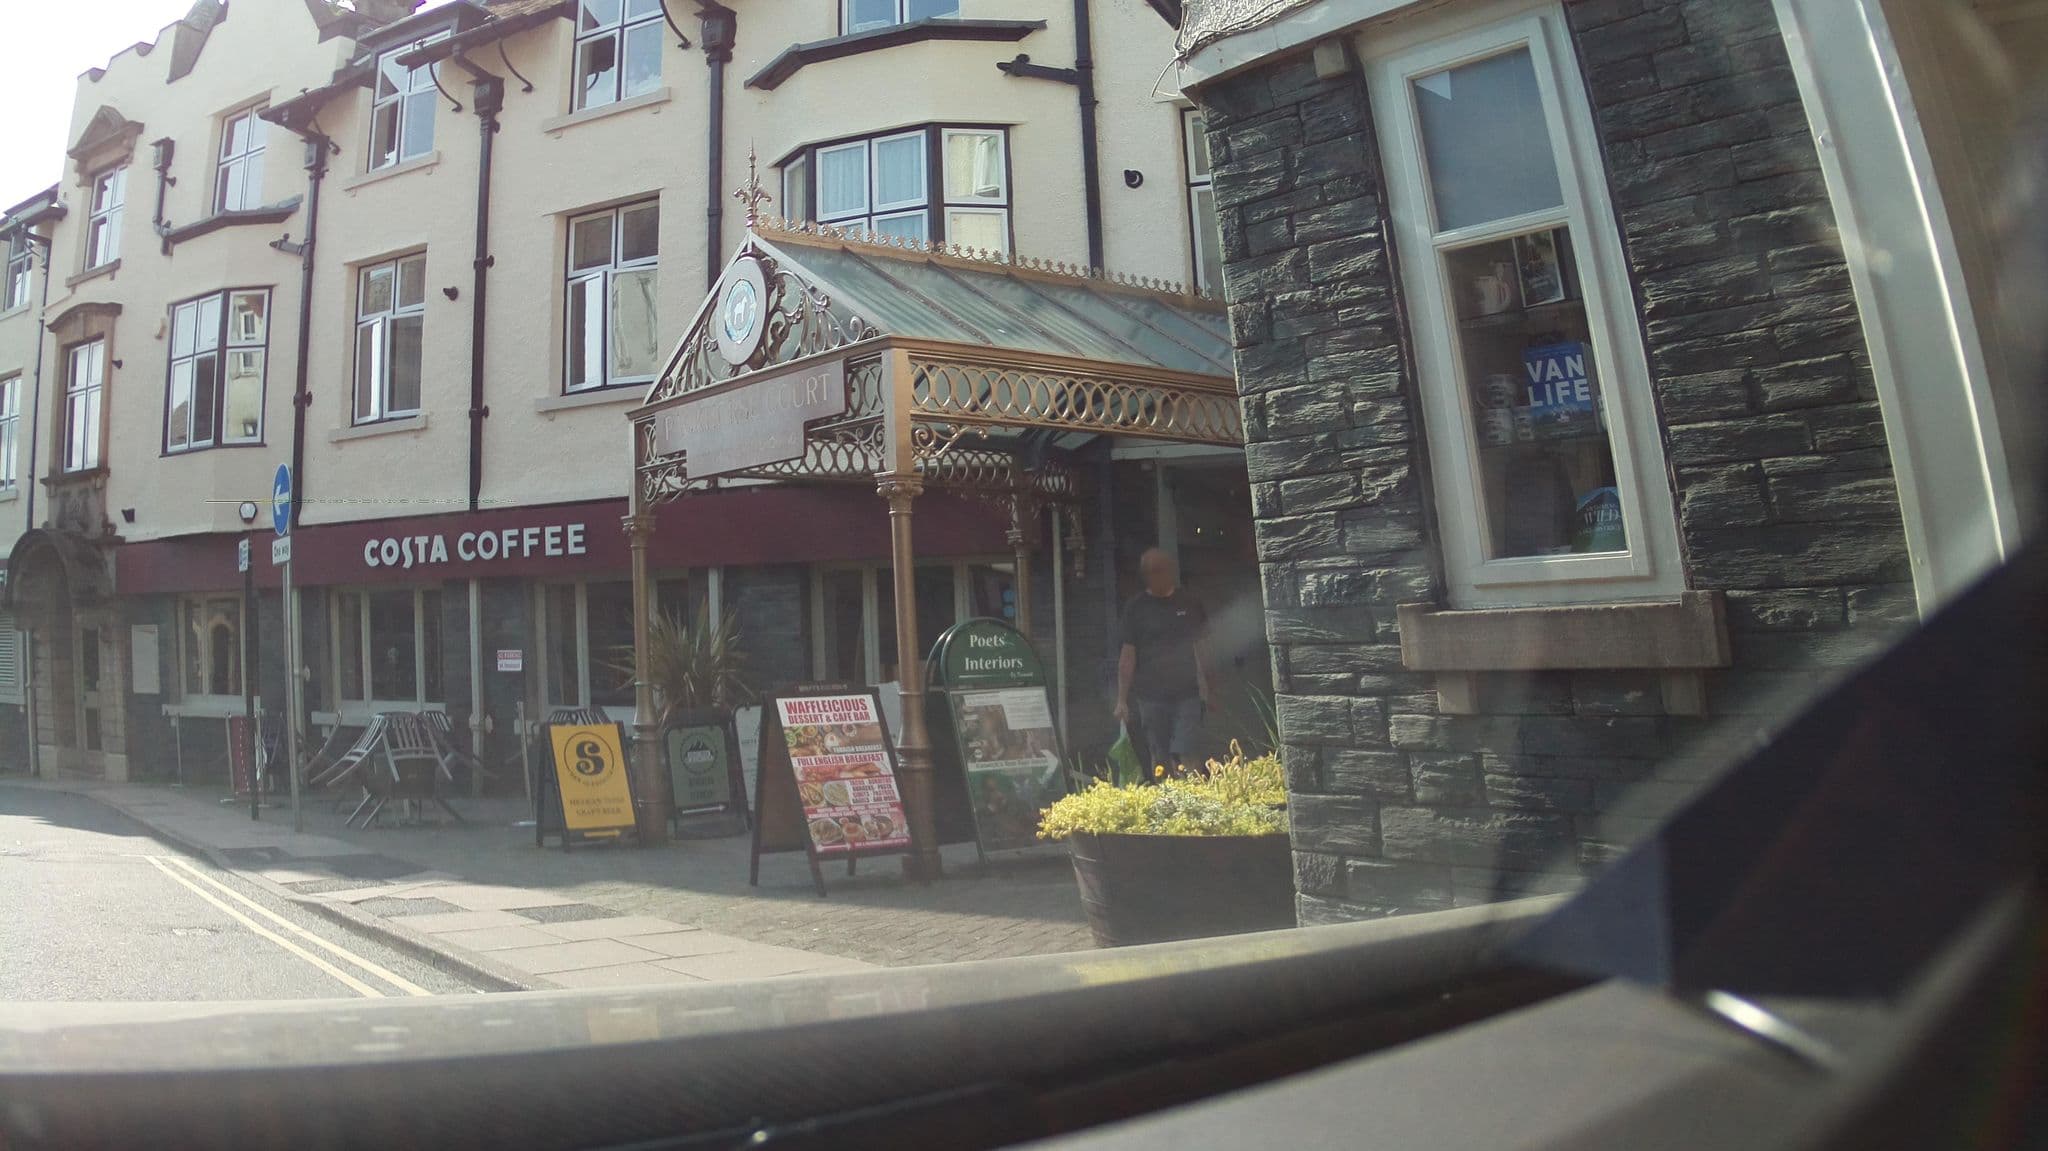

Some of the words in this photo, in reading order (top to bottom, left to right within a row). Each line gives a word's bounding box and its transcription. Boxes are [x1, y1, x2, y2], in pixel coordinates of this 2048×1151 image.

[1526, 354, 1585, 383] VAN
[766, 373, 831, 412] COURT
[1528, 378, 1591, 407] LIFE
[364, 534, 449, 569] COSTA
[457, 523, 587, 561] COFFEE
[964, 655, 1024, 671] Interiors
[784, 698, 868, 714] WAFFLEICIOUS
[788, 713, 824, 725] DESSERT
[825, 714, 832, 723] &
[833, 712, 853, 722] CAFE
[854, 711, 871, 721] BAR
[576, 740, 605, 776] S
[797, 756, 813, 766] FULL
[814, 755, 845, 765] ENGLISH
[845, 753, 884, 763] BREAKFAST
